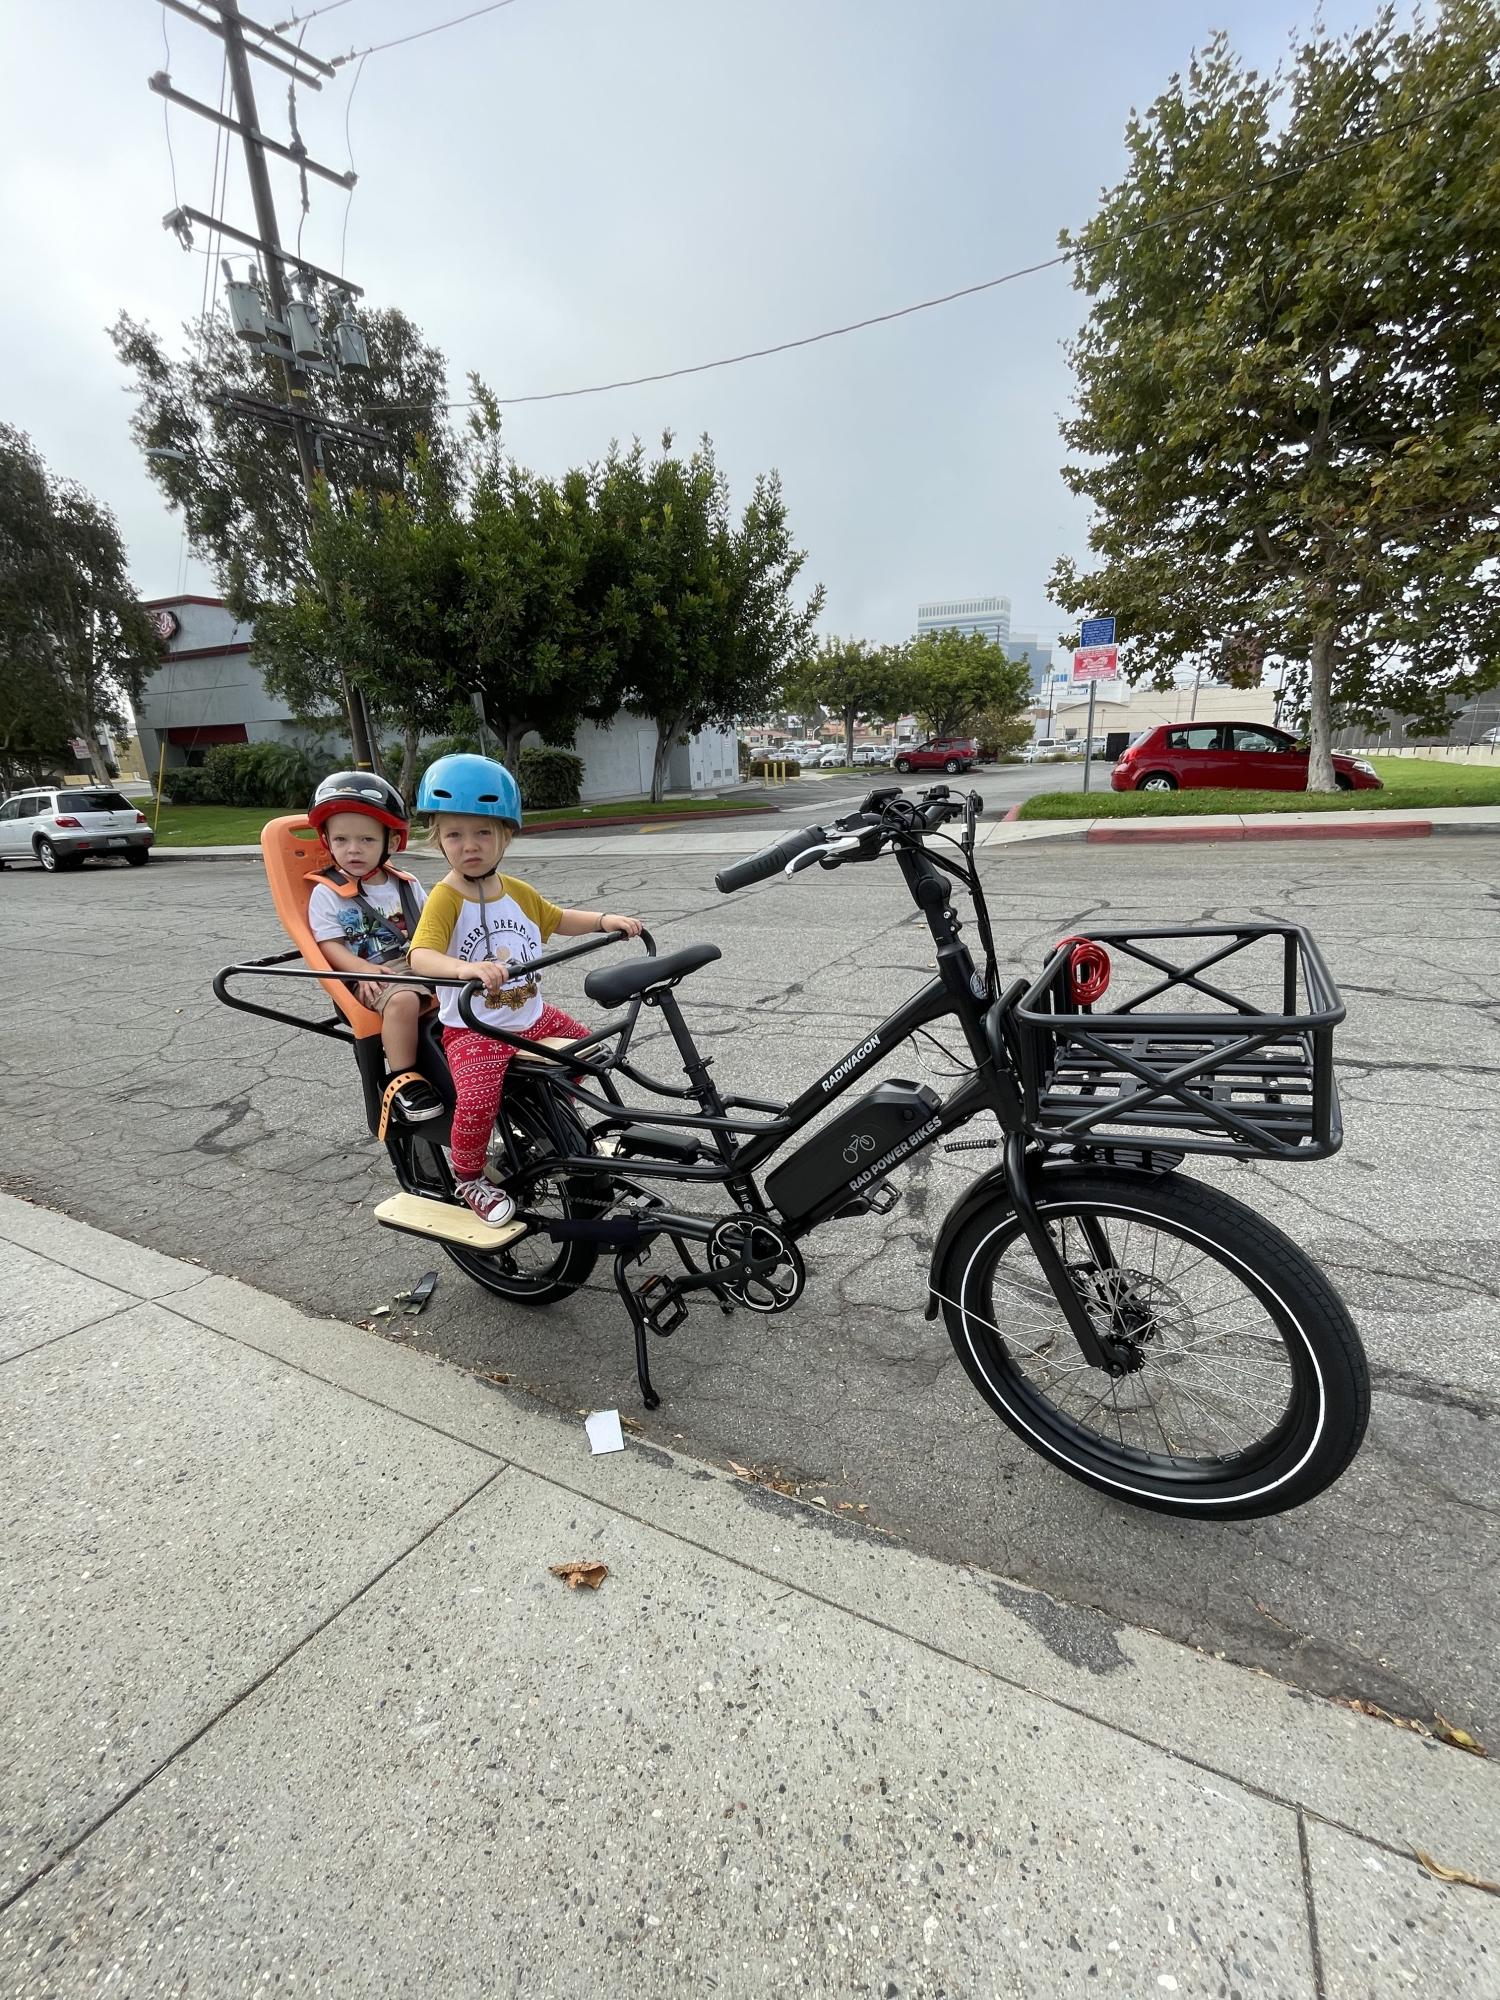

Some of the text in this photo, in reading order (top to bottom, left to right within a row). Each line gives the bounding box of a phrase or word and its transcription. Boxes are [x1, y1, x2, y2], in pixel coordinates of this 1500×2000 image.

[493, 919, 538, 950] DREAMG
[821, 1034, 880, 1092] RADWAGON
[849, 1115, 942, 1191] RAD POWER BIKES
